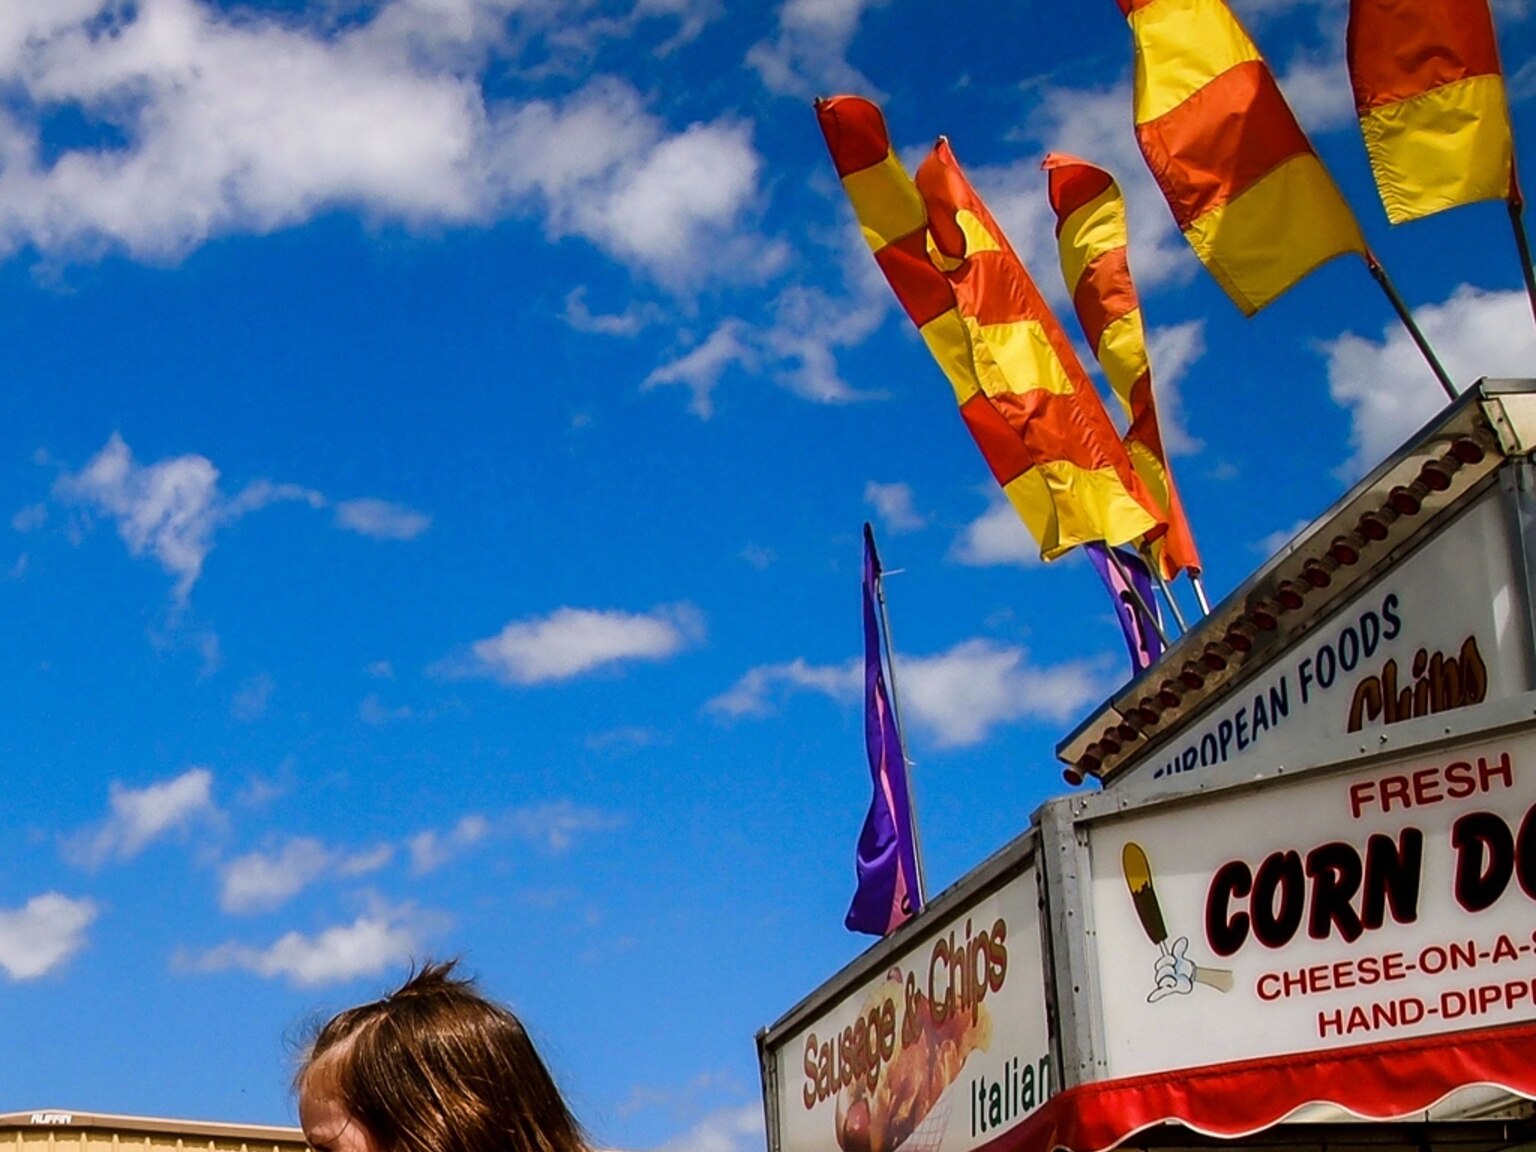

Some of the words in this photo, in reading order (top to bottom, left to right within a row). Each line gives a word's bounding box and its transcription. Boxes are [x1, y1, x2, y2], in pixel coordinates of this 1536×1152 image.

[1299, 593, 1401, 703] FOODS
[1349, 752, 1513, 817] FRESH
[1205, 826, 1423, 957] CORN
[1451, 803, 1536, 913] D
[803, 997, 896, 1110] Sausage
[901, 970, 924, 1047] &
[930, 918, 1007, 1030] Chips
[1256, 930, 1536, 1001] CHEESE-ON-A-
[971, 1053, 1052, 1138] Italian
